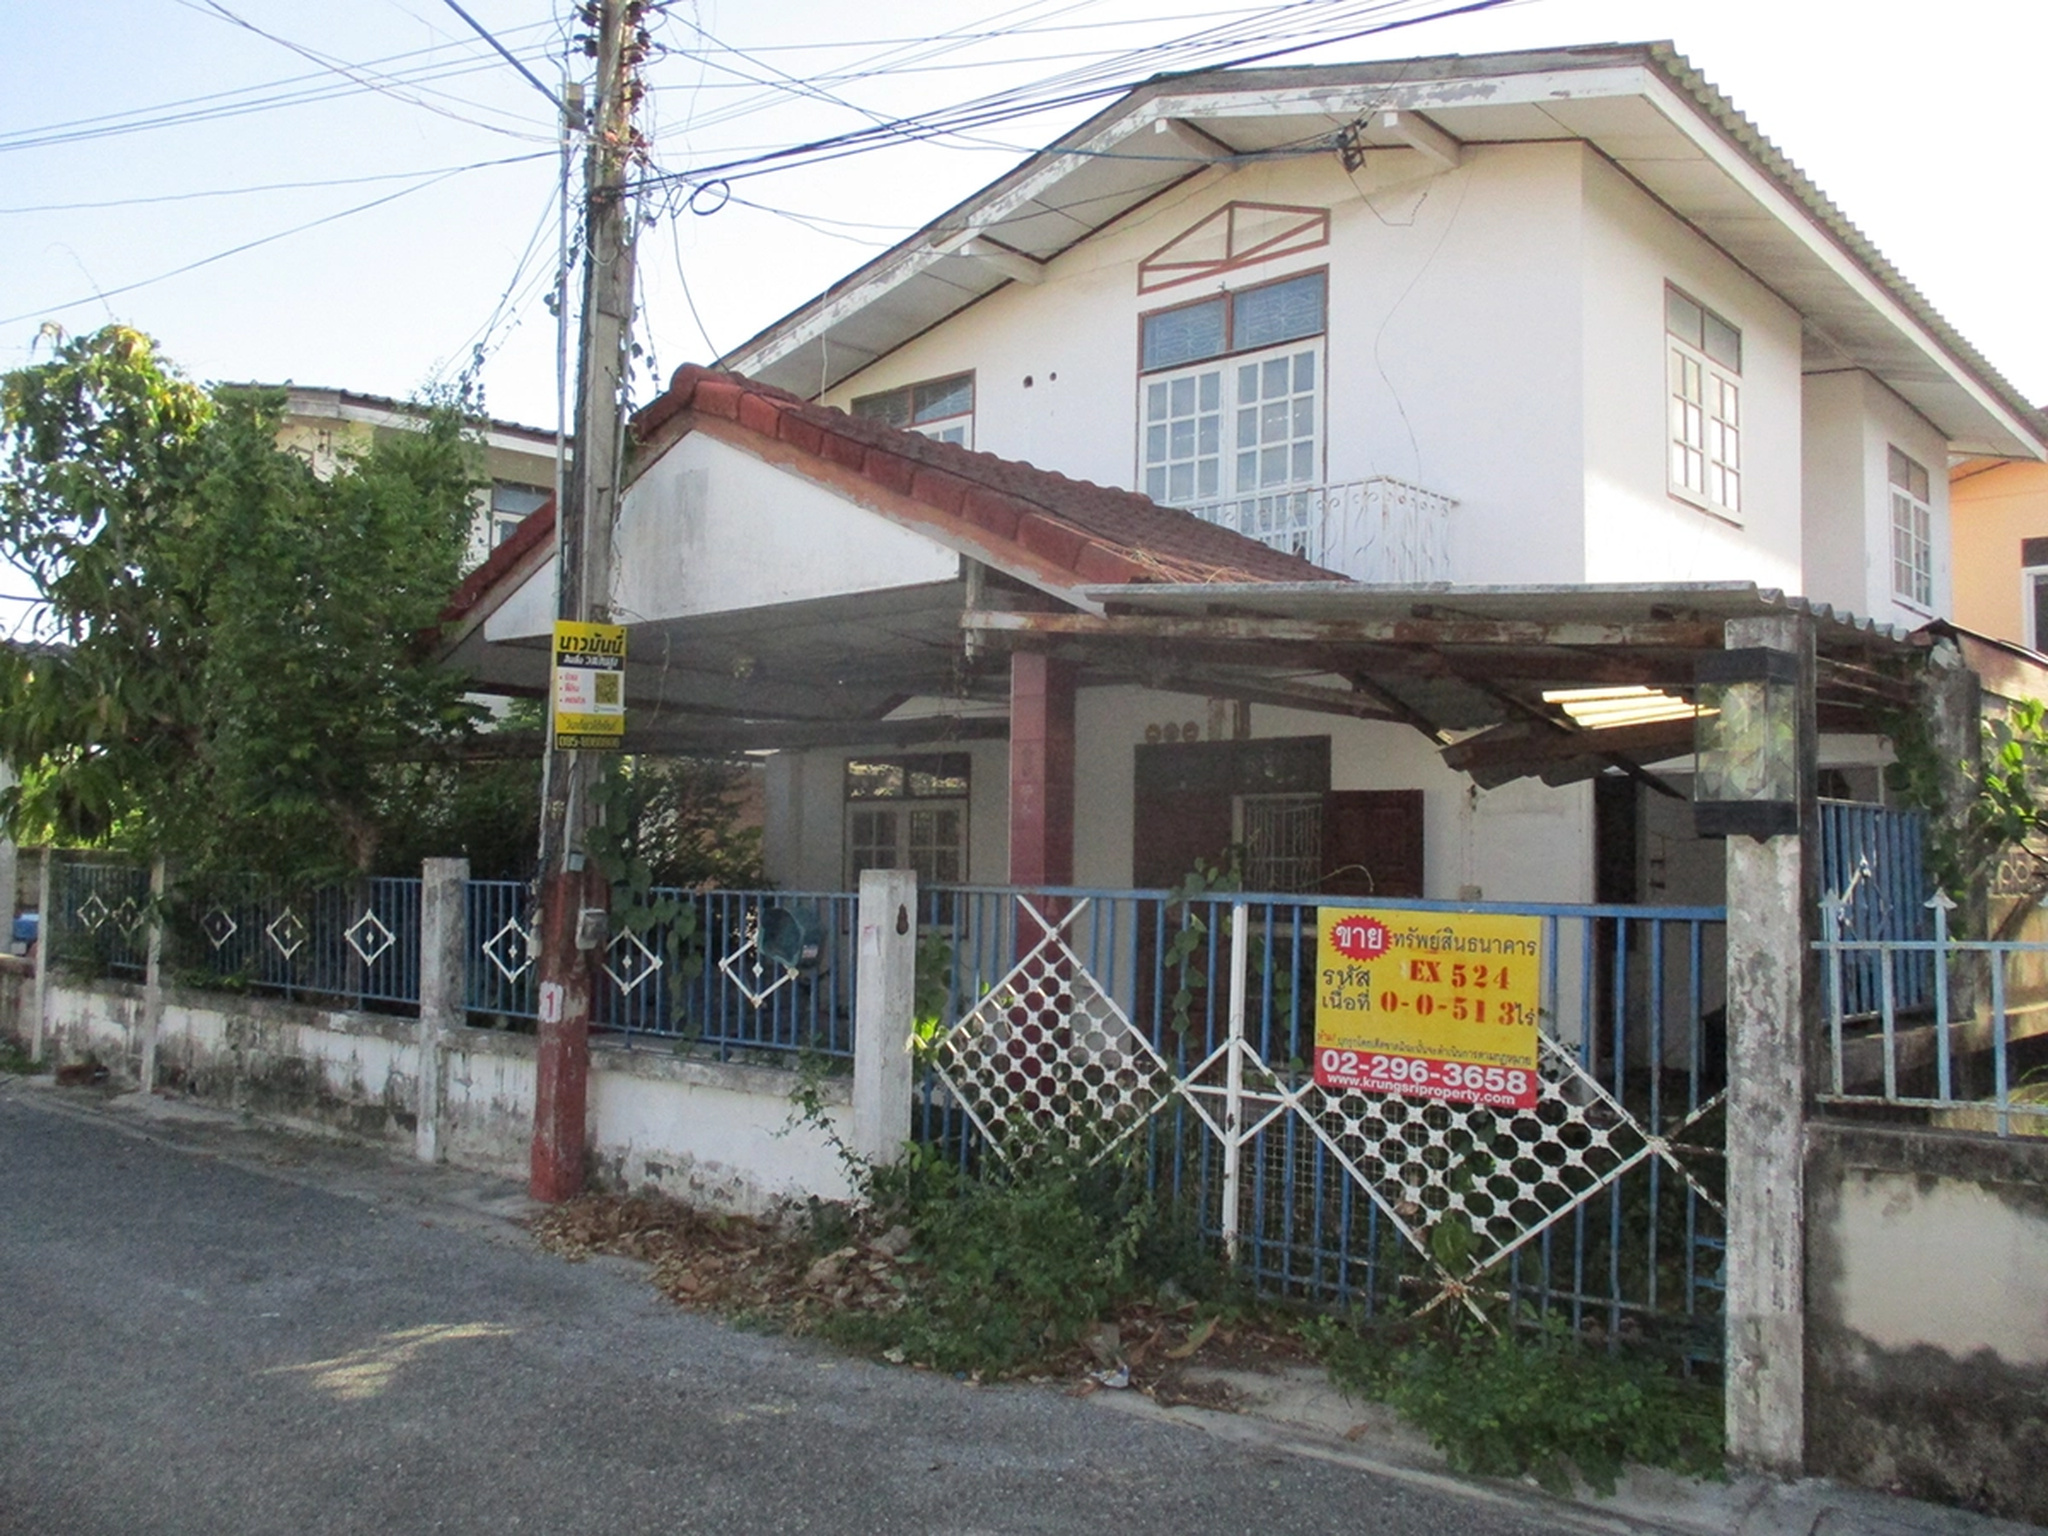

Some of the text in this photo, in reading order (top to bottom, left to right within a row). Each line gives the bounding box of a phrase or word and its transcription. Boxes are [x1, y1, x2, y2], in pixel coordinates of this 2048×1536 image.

[560, 629, 625, 653] นาวมันนี่
[1335, 925, 1383, 950] ขาย
[1393, 926, 1537, 957] ทรัพย์สินธนาคาร
[1322, 964, 1371, 987] รหัส
[1409, 959, 1441, 982] EX
[546, 991, 554, 1018] 1
[1321, 985, 1371, 1011] เนื้อที่
[1513, 1001, 1536, 1026] ไร่
[1321, 1049, 1528, 1094] 02-296-3658
[1327, 1073, 1516, 1105] www.krungsriproperty.com
